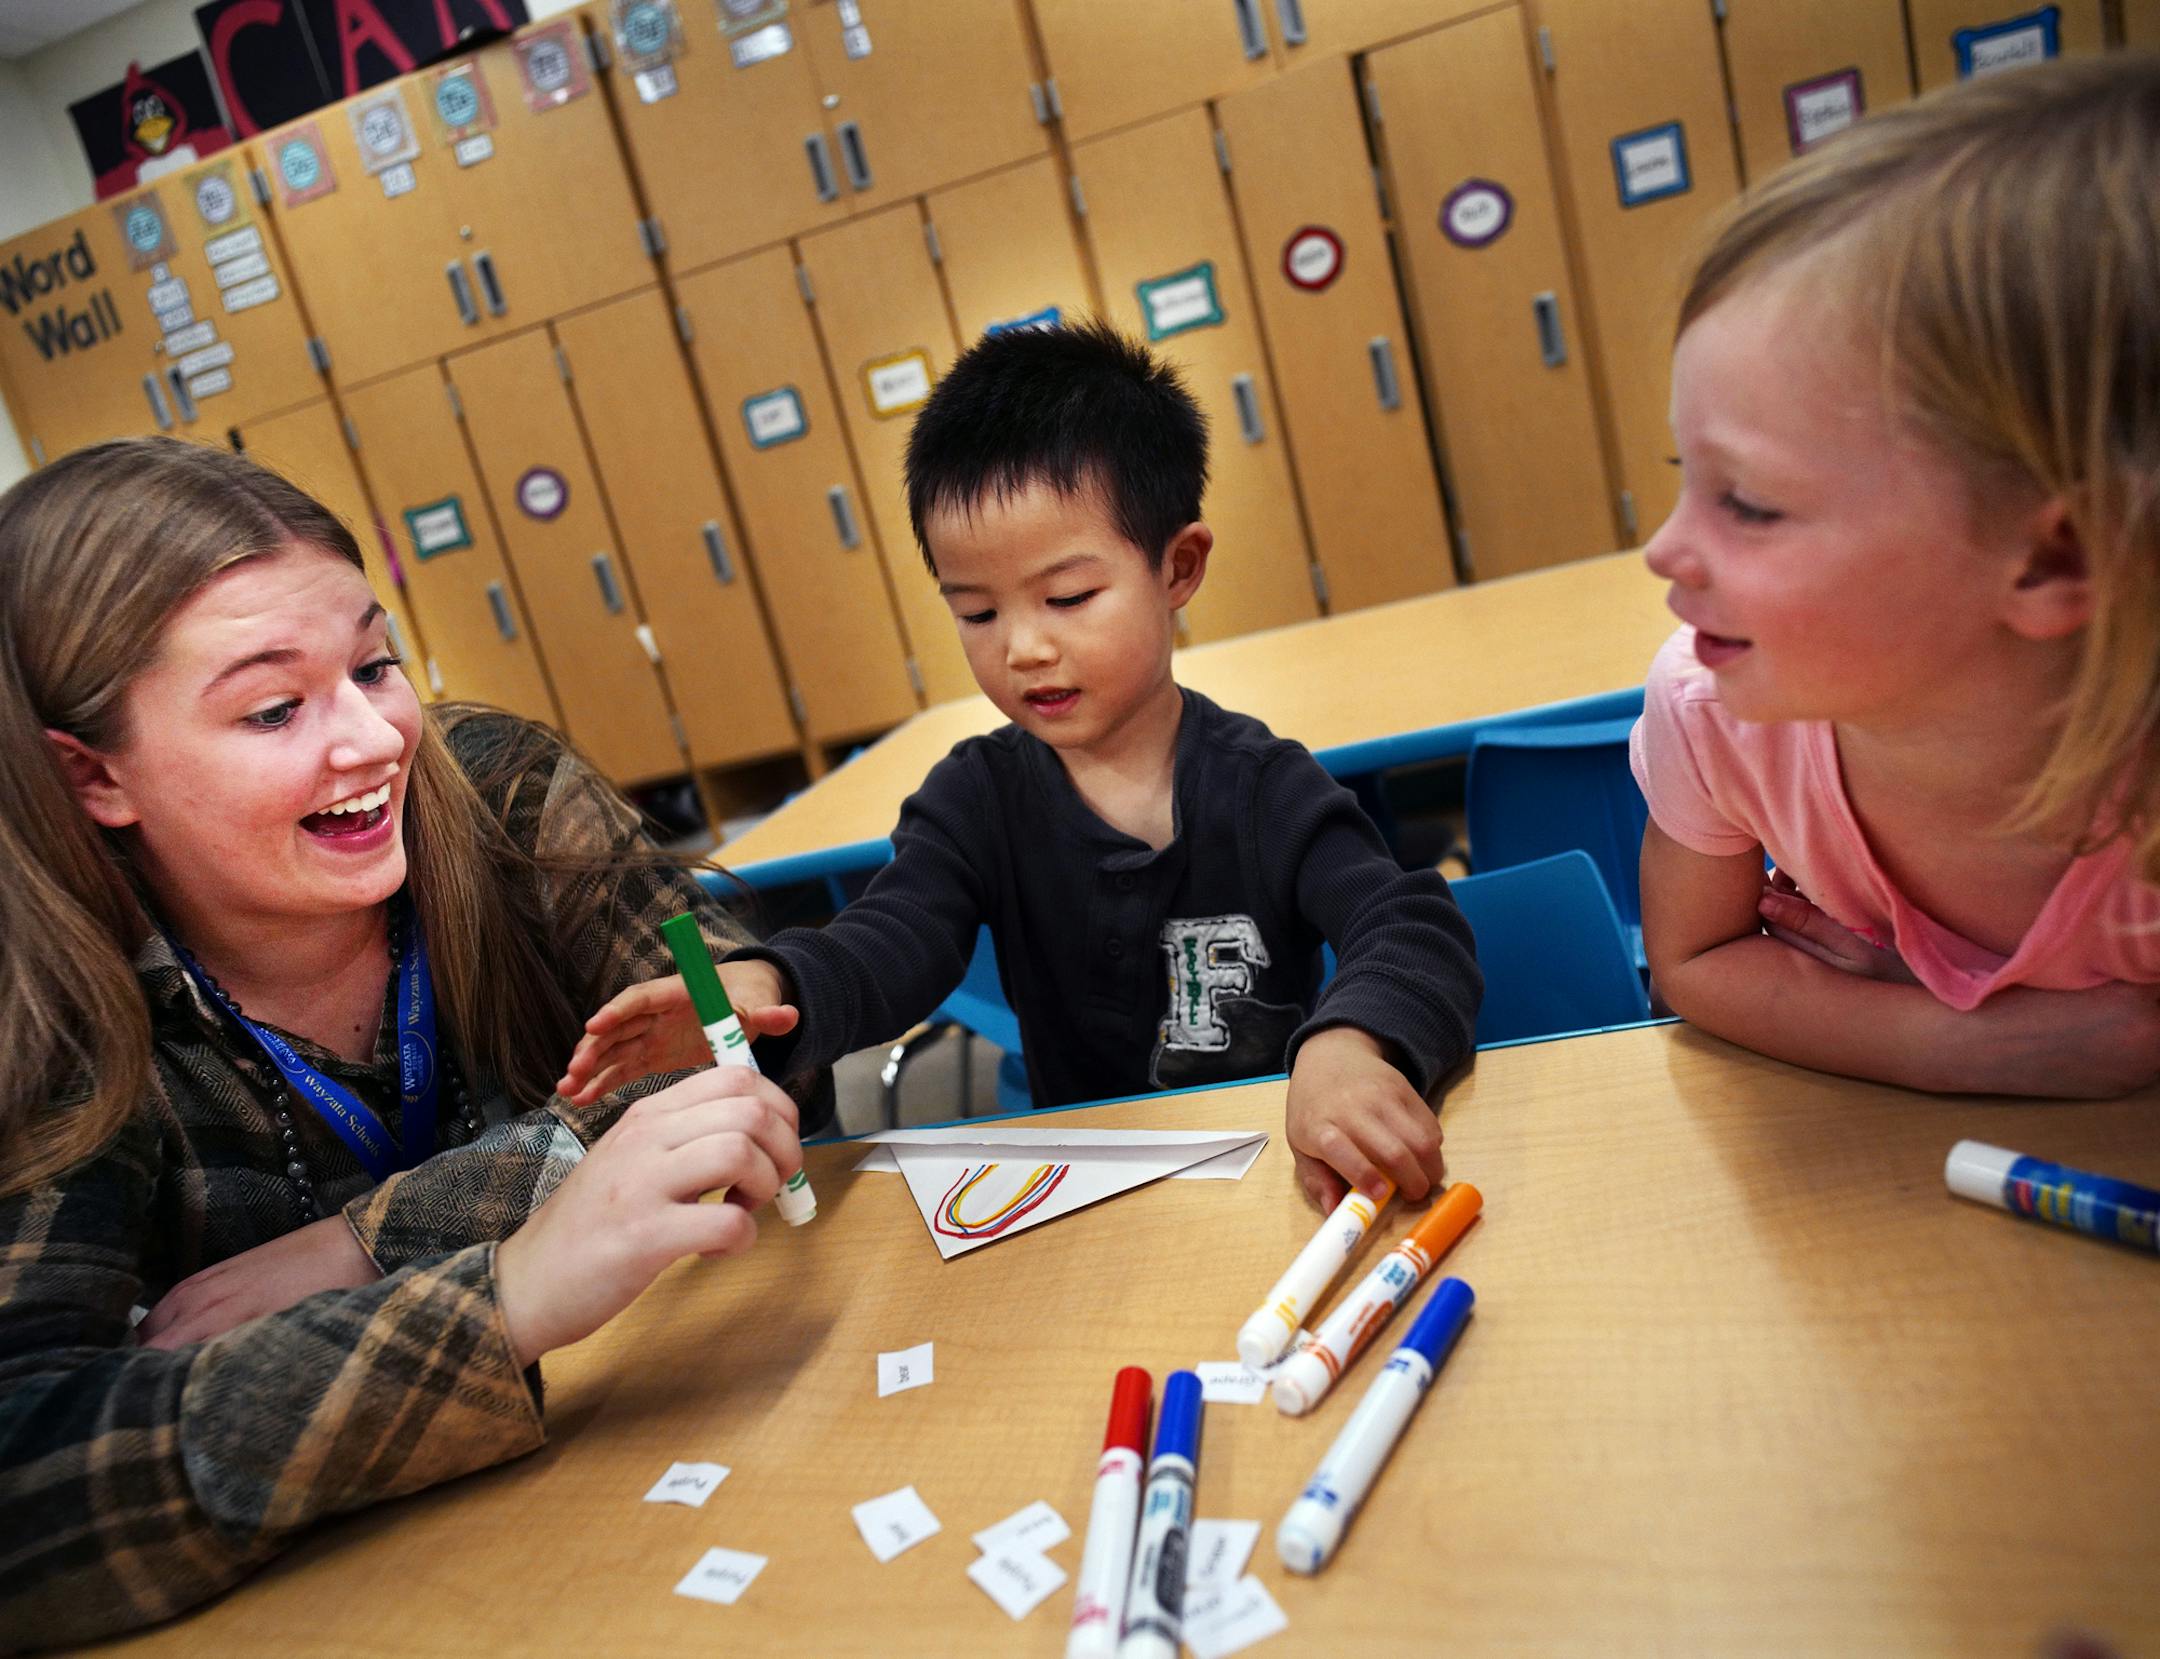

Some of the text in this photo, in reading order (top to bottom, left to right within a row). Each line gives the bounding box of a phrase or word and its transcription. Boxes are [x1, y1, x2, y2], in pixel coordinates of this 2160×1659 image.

[0, 228, 96, 316] Word
[23, 287, 124, 362] Wall
[407, 974, 424, 1026] Wayzata
[403, 1043, 416, 1091] WAYZATA
[304, 1074, 381, 1158] Wayzata Schools
